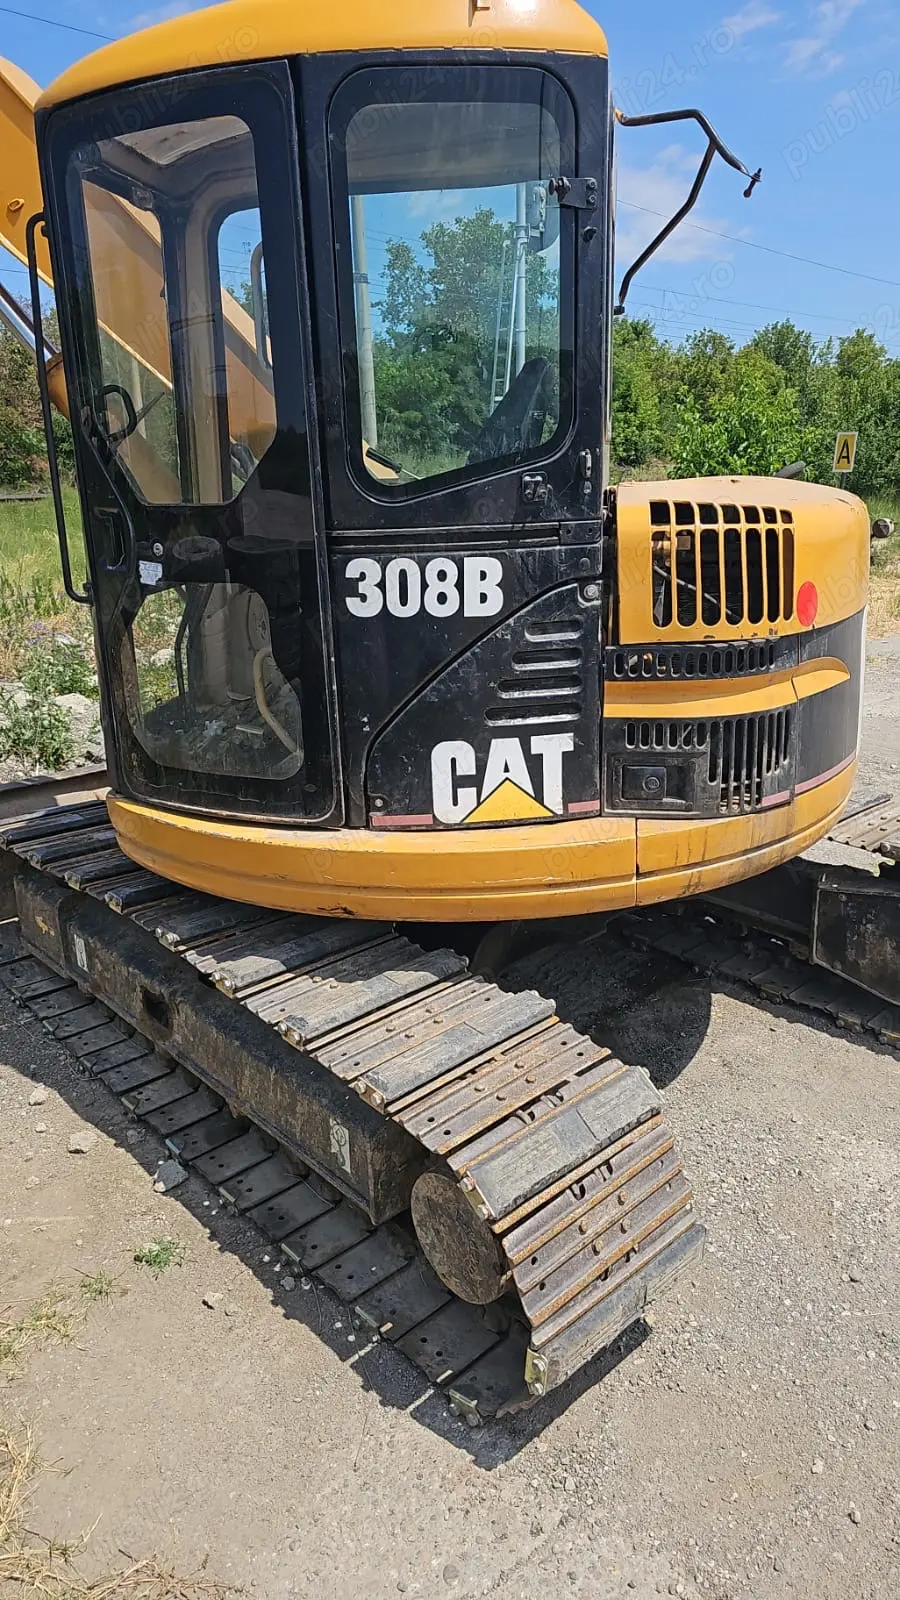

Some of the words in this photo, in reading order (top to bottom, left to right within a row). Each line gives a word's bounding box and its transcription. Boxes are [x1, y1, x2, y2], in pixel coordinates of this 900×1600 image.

[836, 438, 851, 465] A
[345, 557, 504, 618] 308B
[431, 733, 574, 824] CAT
